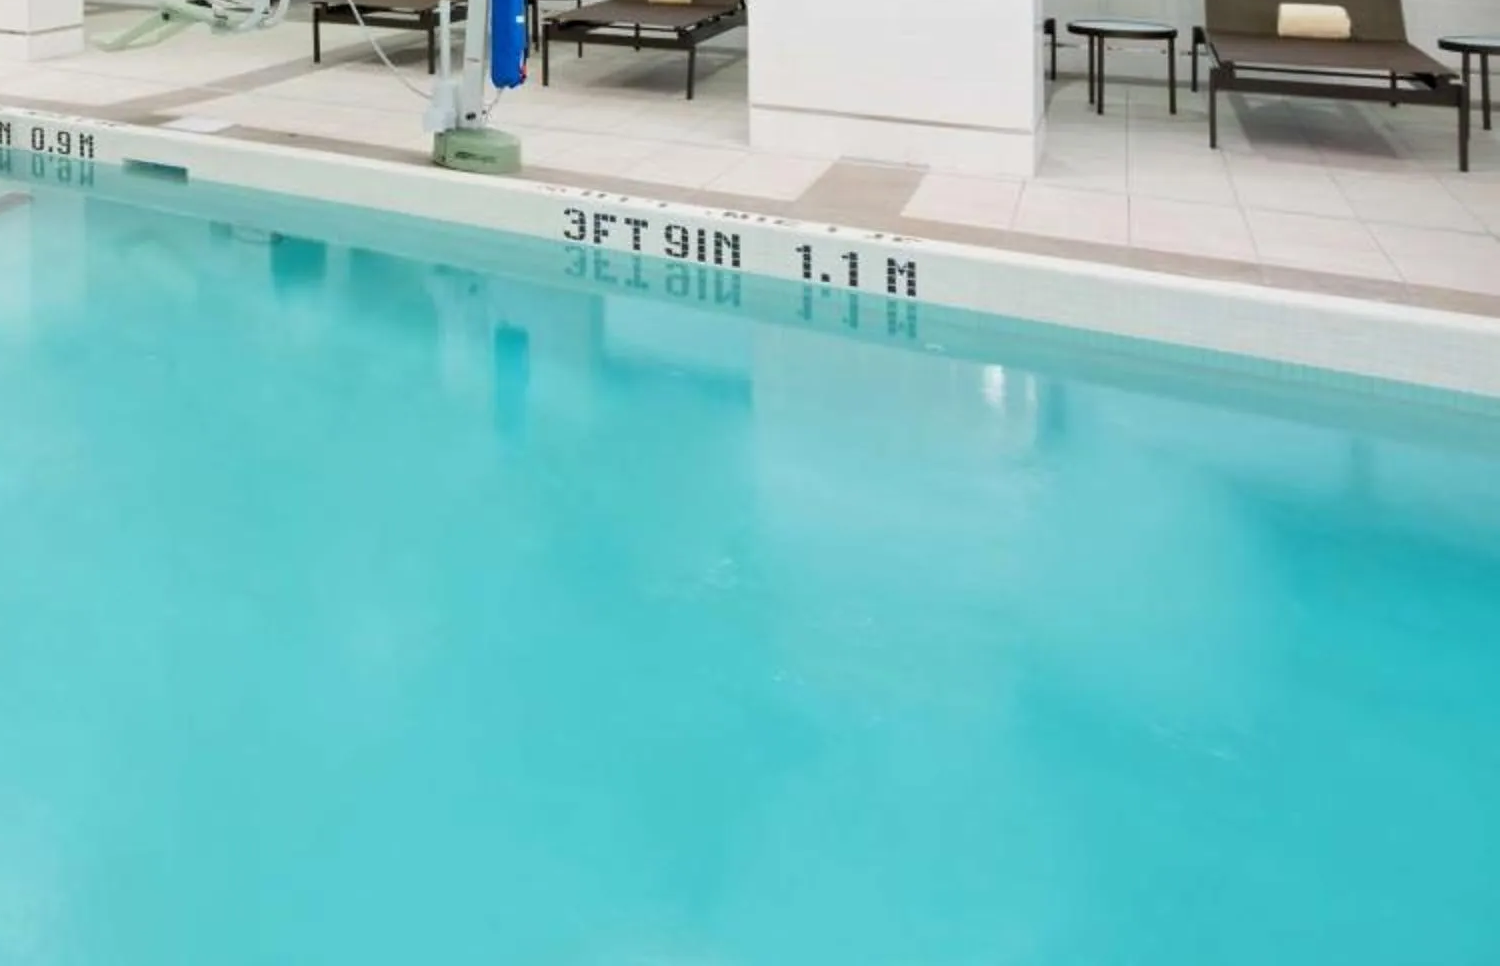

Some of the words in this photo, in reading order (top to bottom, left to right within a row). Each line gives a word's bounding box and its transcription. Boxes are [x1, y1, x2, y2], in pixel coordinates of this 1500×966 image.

[31, 127, 72, 155] 0.9
[79, 131, 95, 159] M
[563, 208, 649, 251] 3FT
[664, 224, 742, 268] 9IN
[796, 244, 859, 287] 1.1
[887, 257, 917, 297] M
